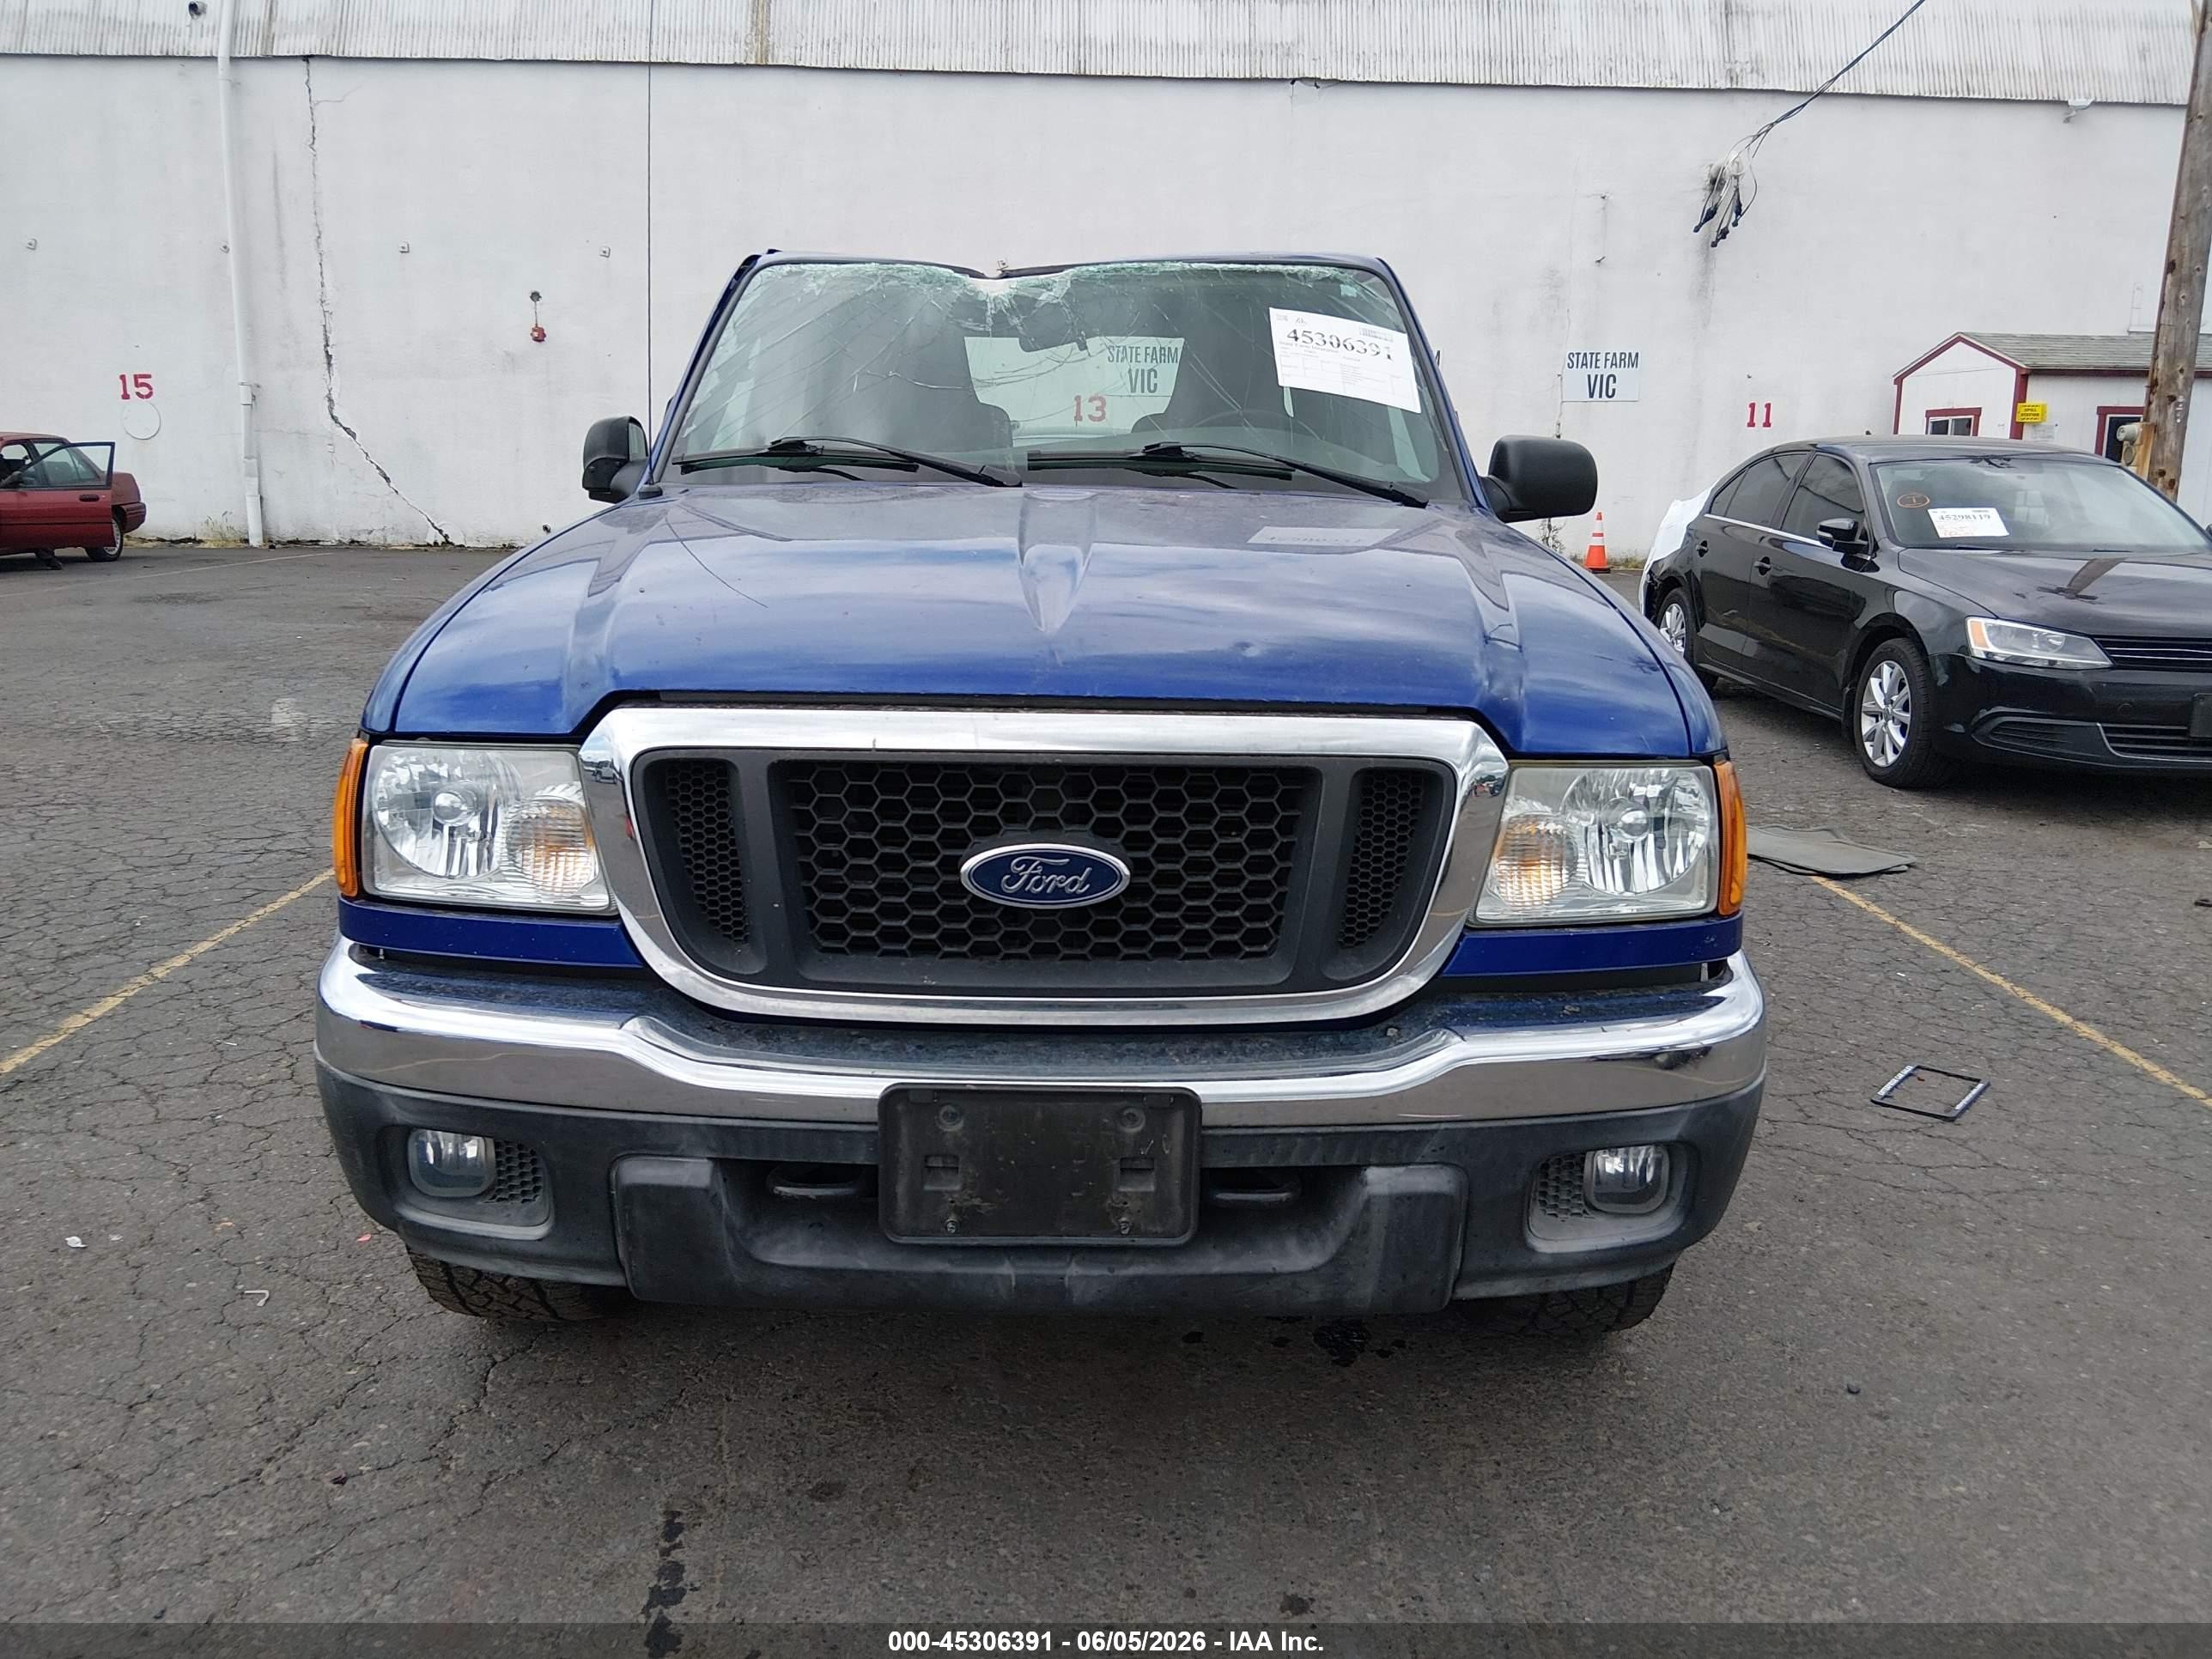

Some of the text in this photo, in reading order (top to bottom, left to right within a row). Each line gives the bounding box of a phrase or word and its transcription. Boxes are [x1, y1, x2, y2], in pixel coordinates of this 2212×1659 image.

[1108, 345, 1178, 363] STATE FARM
[1287, 328, 1394, 362] 45306391
[1567, 351, 1639, 369] STATE FARM
[119, 374, 153, 399] 15
[1128, 368, 1158, 394] VIC
[1587, 374, 1617, 399] VIC
[1074, 395, 1107, 422] 13
[1747, 402, 1771, 428] 11
[1001, 856, 1092, 895] Ford
